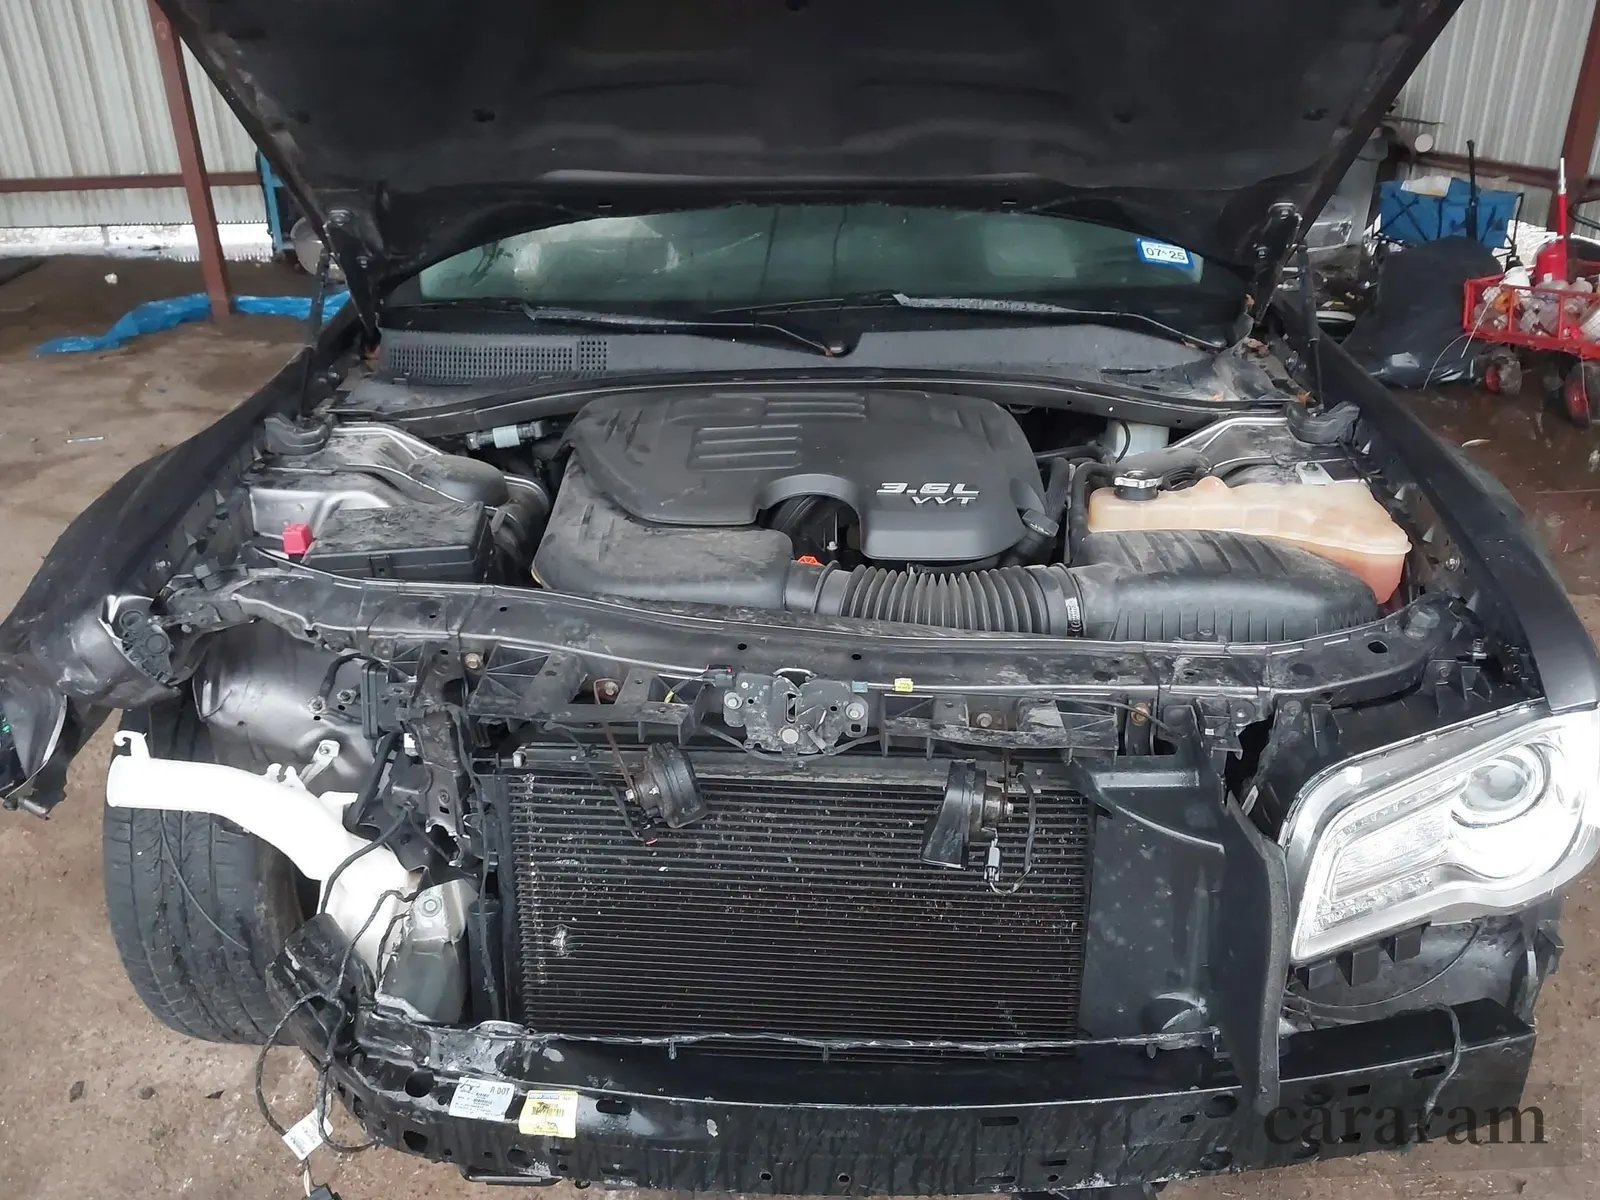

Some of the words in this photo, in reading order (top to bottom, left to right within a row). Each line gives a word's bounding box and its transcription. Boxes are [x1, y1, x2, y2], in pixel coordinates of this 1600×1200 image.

[1146, 247, 1161, 257] 07
[1169, 250, 1186, 261] 25
[876, 482, 980, 494] 3.6L
[911, 496, 977, 504] VVT
